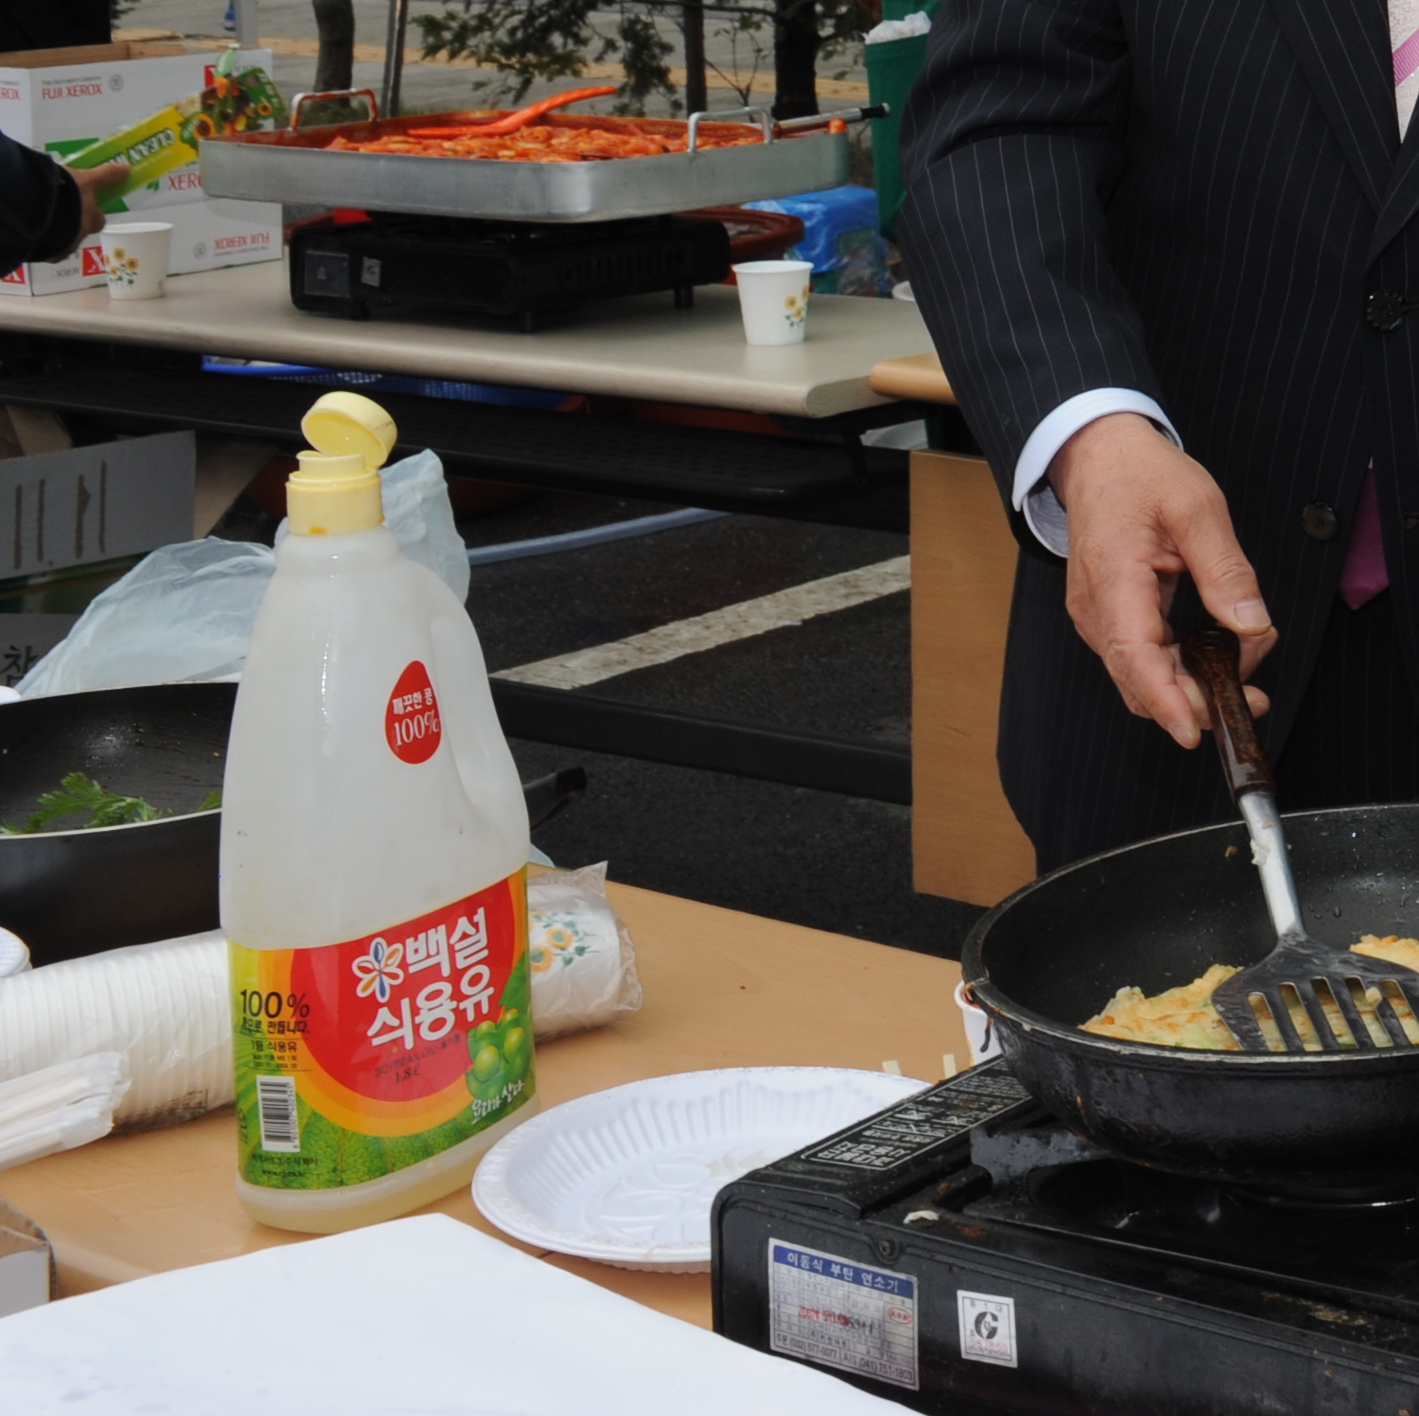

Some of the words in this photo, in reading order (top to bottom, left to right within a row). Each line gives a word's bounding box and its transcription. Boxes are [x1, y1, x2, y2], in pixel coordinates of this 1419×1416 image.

[42, 86, 64, 100] FUJI
[66, 83, 103, 97] XEROX
[393, 709, 440, 746] 100%
[405, 906, 490, 978] 백설
[240, 989, 310, 1019] 100%
[366, 964, 495, 1051] 식용유
[787, 1251, 823, 1273] 이동식
[830, 1263, 854, 1282] 부탄
[861, 1271, 899, 1293] 연소기
